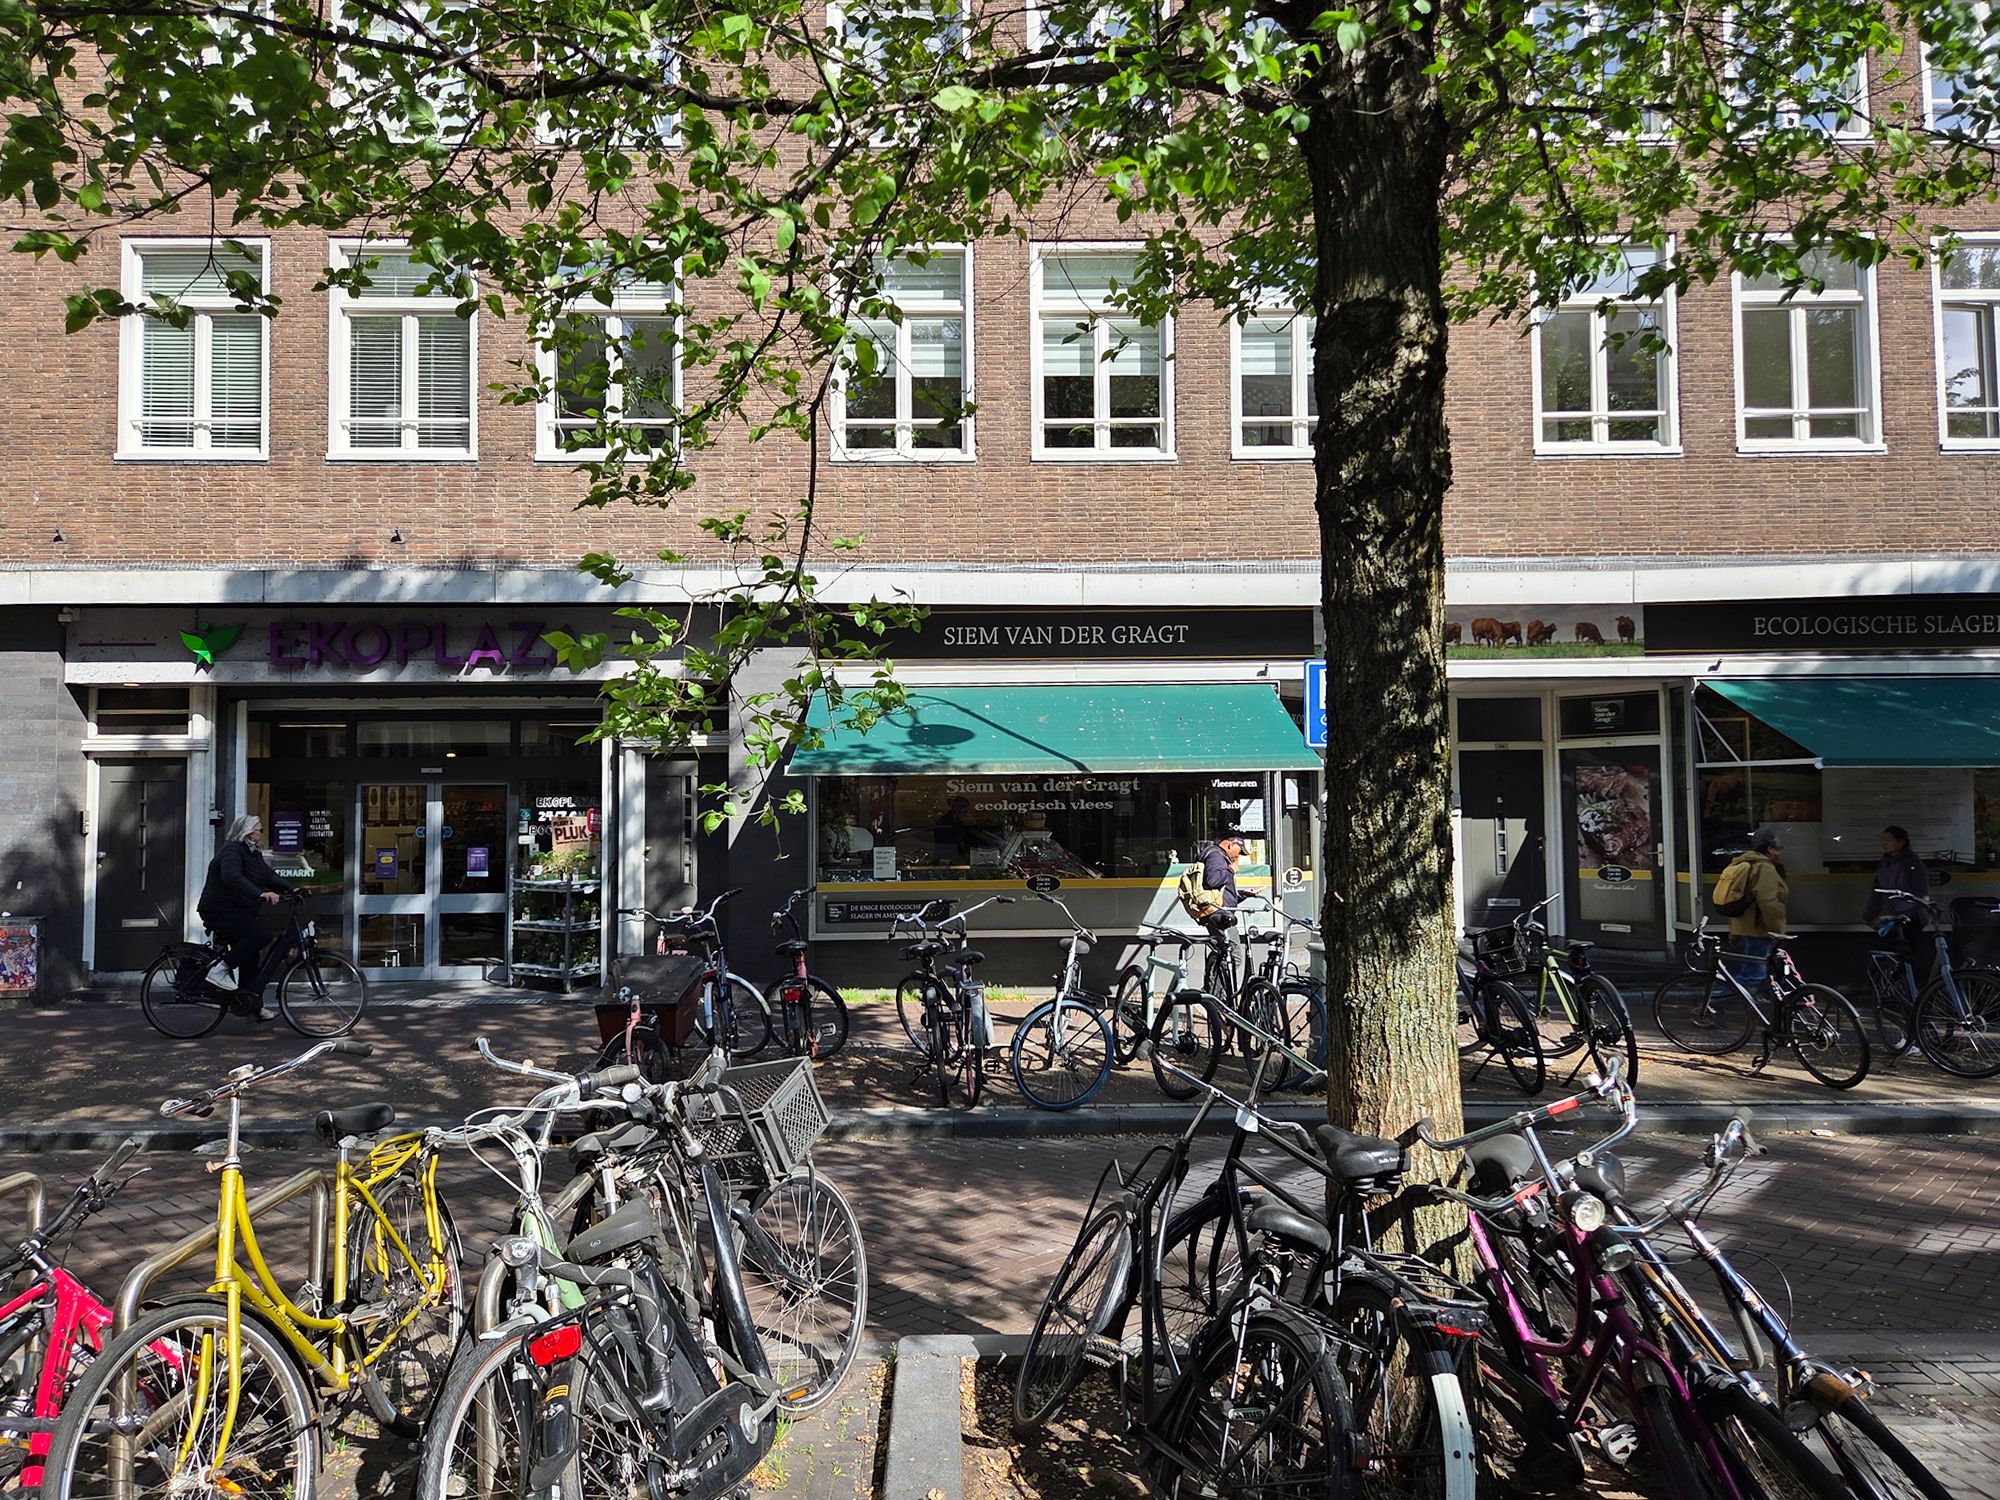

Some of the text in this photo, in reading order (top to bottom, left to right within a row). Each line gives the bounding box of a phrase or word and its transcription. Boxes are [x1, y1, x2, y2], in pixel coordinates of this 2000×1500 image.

[1753, 614, 2000, 635] ECOLOGISCHE SLAGE
[943, 624, 1190, 646] SIEM VAN DER GRAGT
[946, 777, 1141, 795] Siem van der Gragt
[1211, 779, 1258, 788] Vleeswaren
[975, 800, 1114, 814] ecologisch vlees
[555, 825, 588, 840] PLUK
